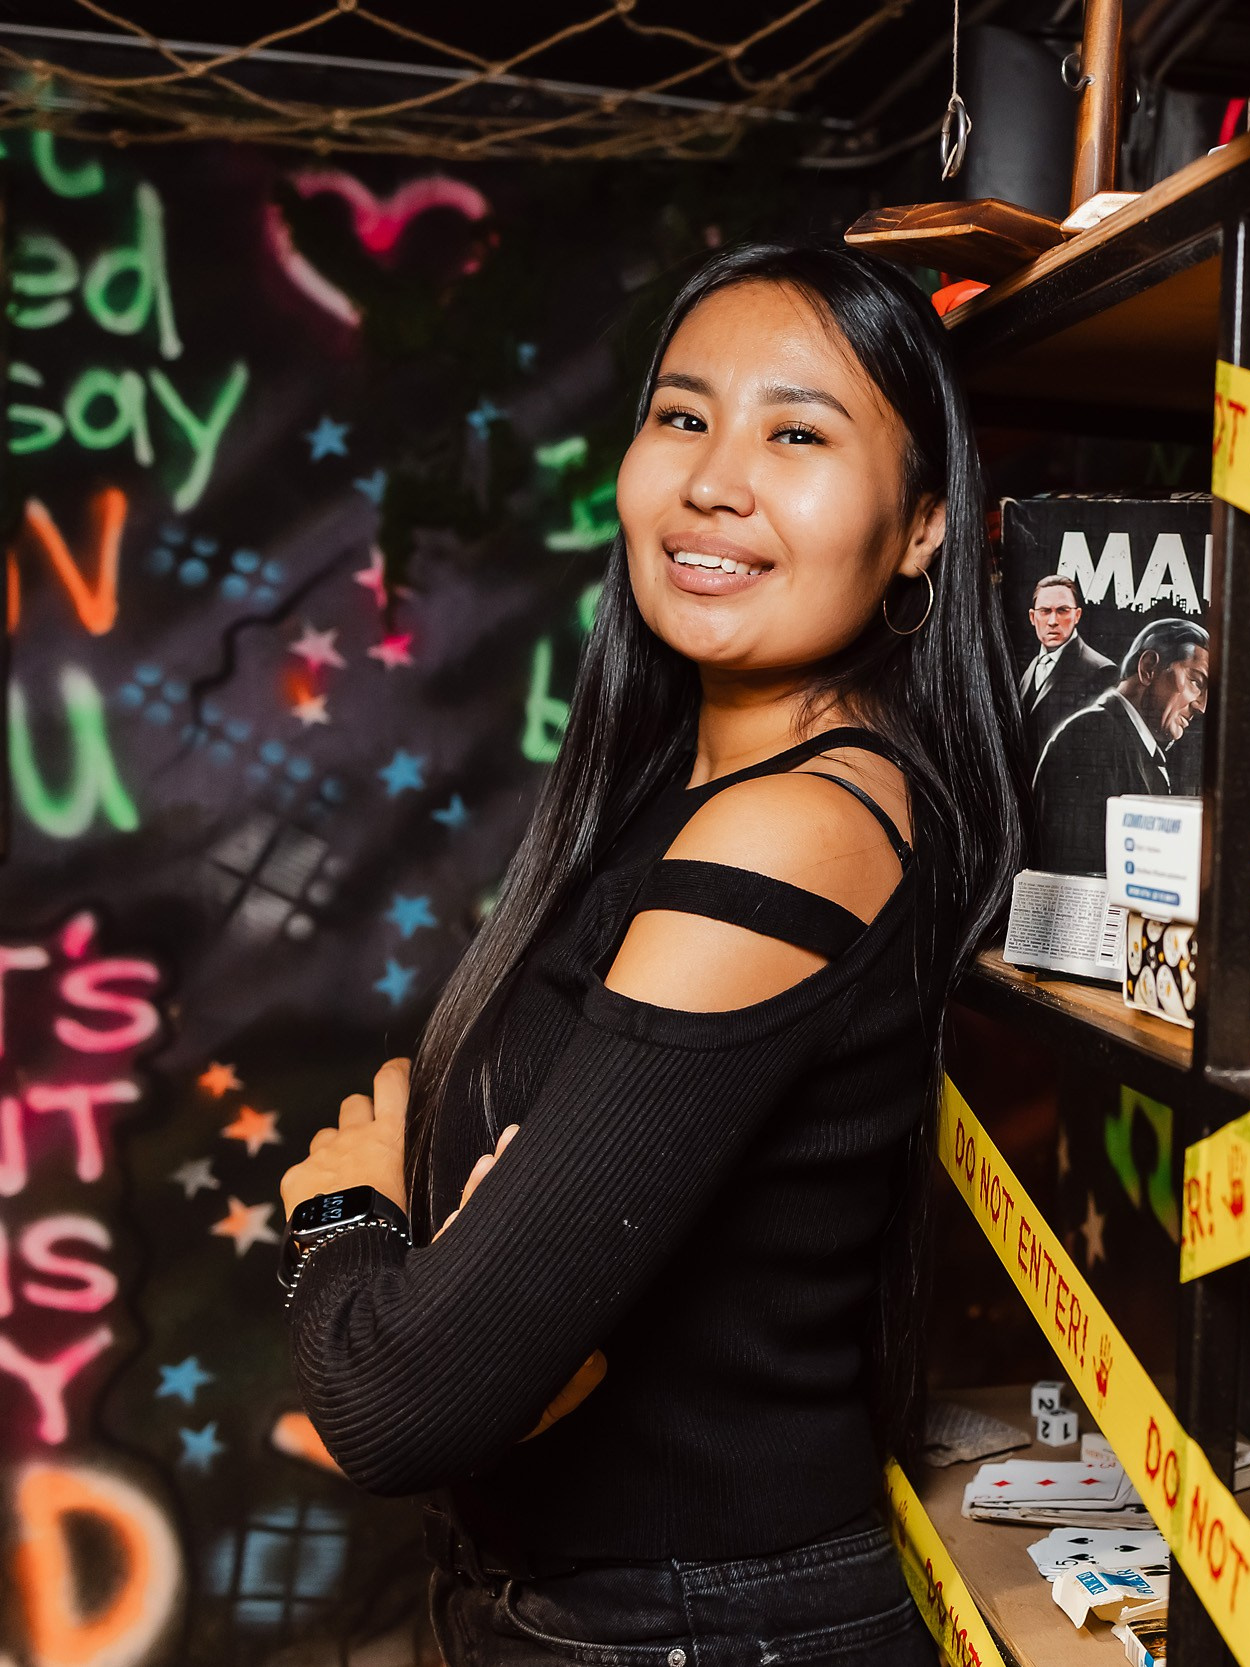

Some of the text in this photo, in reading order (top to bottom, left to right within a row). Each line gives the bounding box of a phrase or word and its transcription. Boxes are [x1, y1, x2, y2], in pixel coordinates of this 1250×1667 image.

[955, 1117, 976, 1185] DO
[980, 1156, 1015, 1243] NOT
[1017, 1215, 1089, 1369] ENTER!
[1145, 1416, 1180, 1511] DO
[1188, 1483, 1250, 1618] NOT
[926, 1558, 947, 1627] DO
[1077, 1571, 1108, 1595] BEAR
